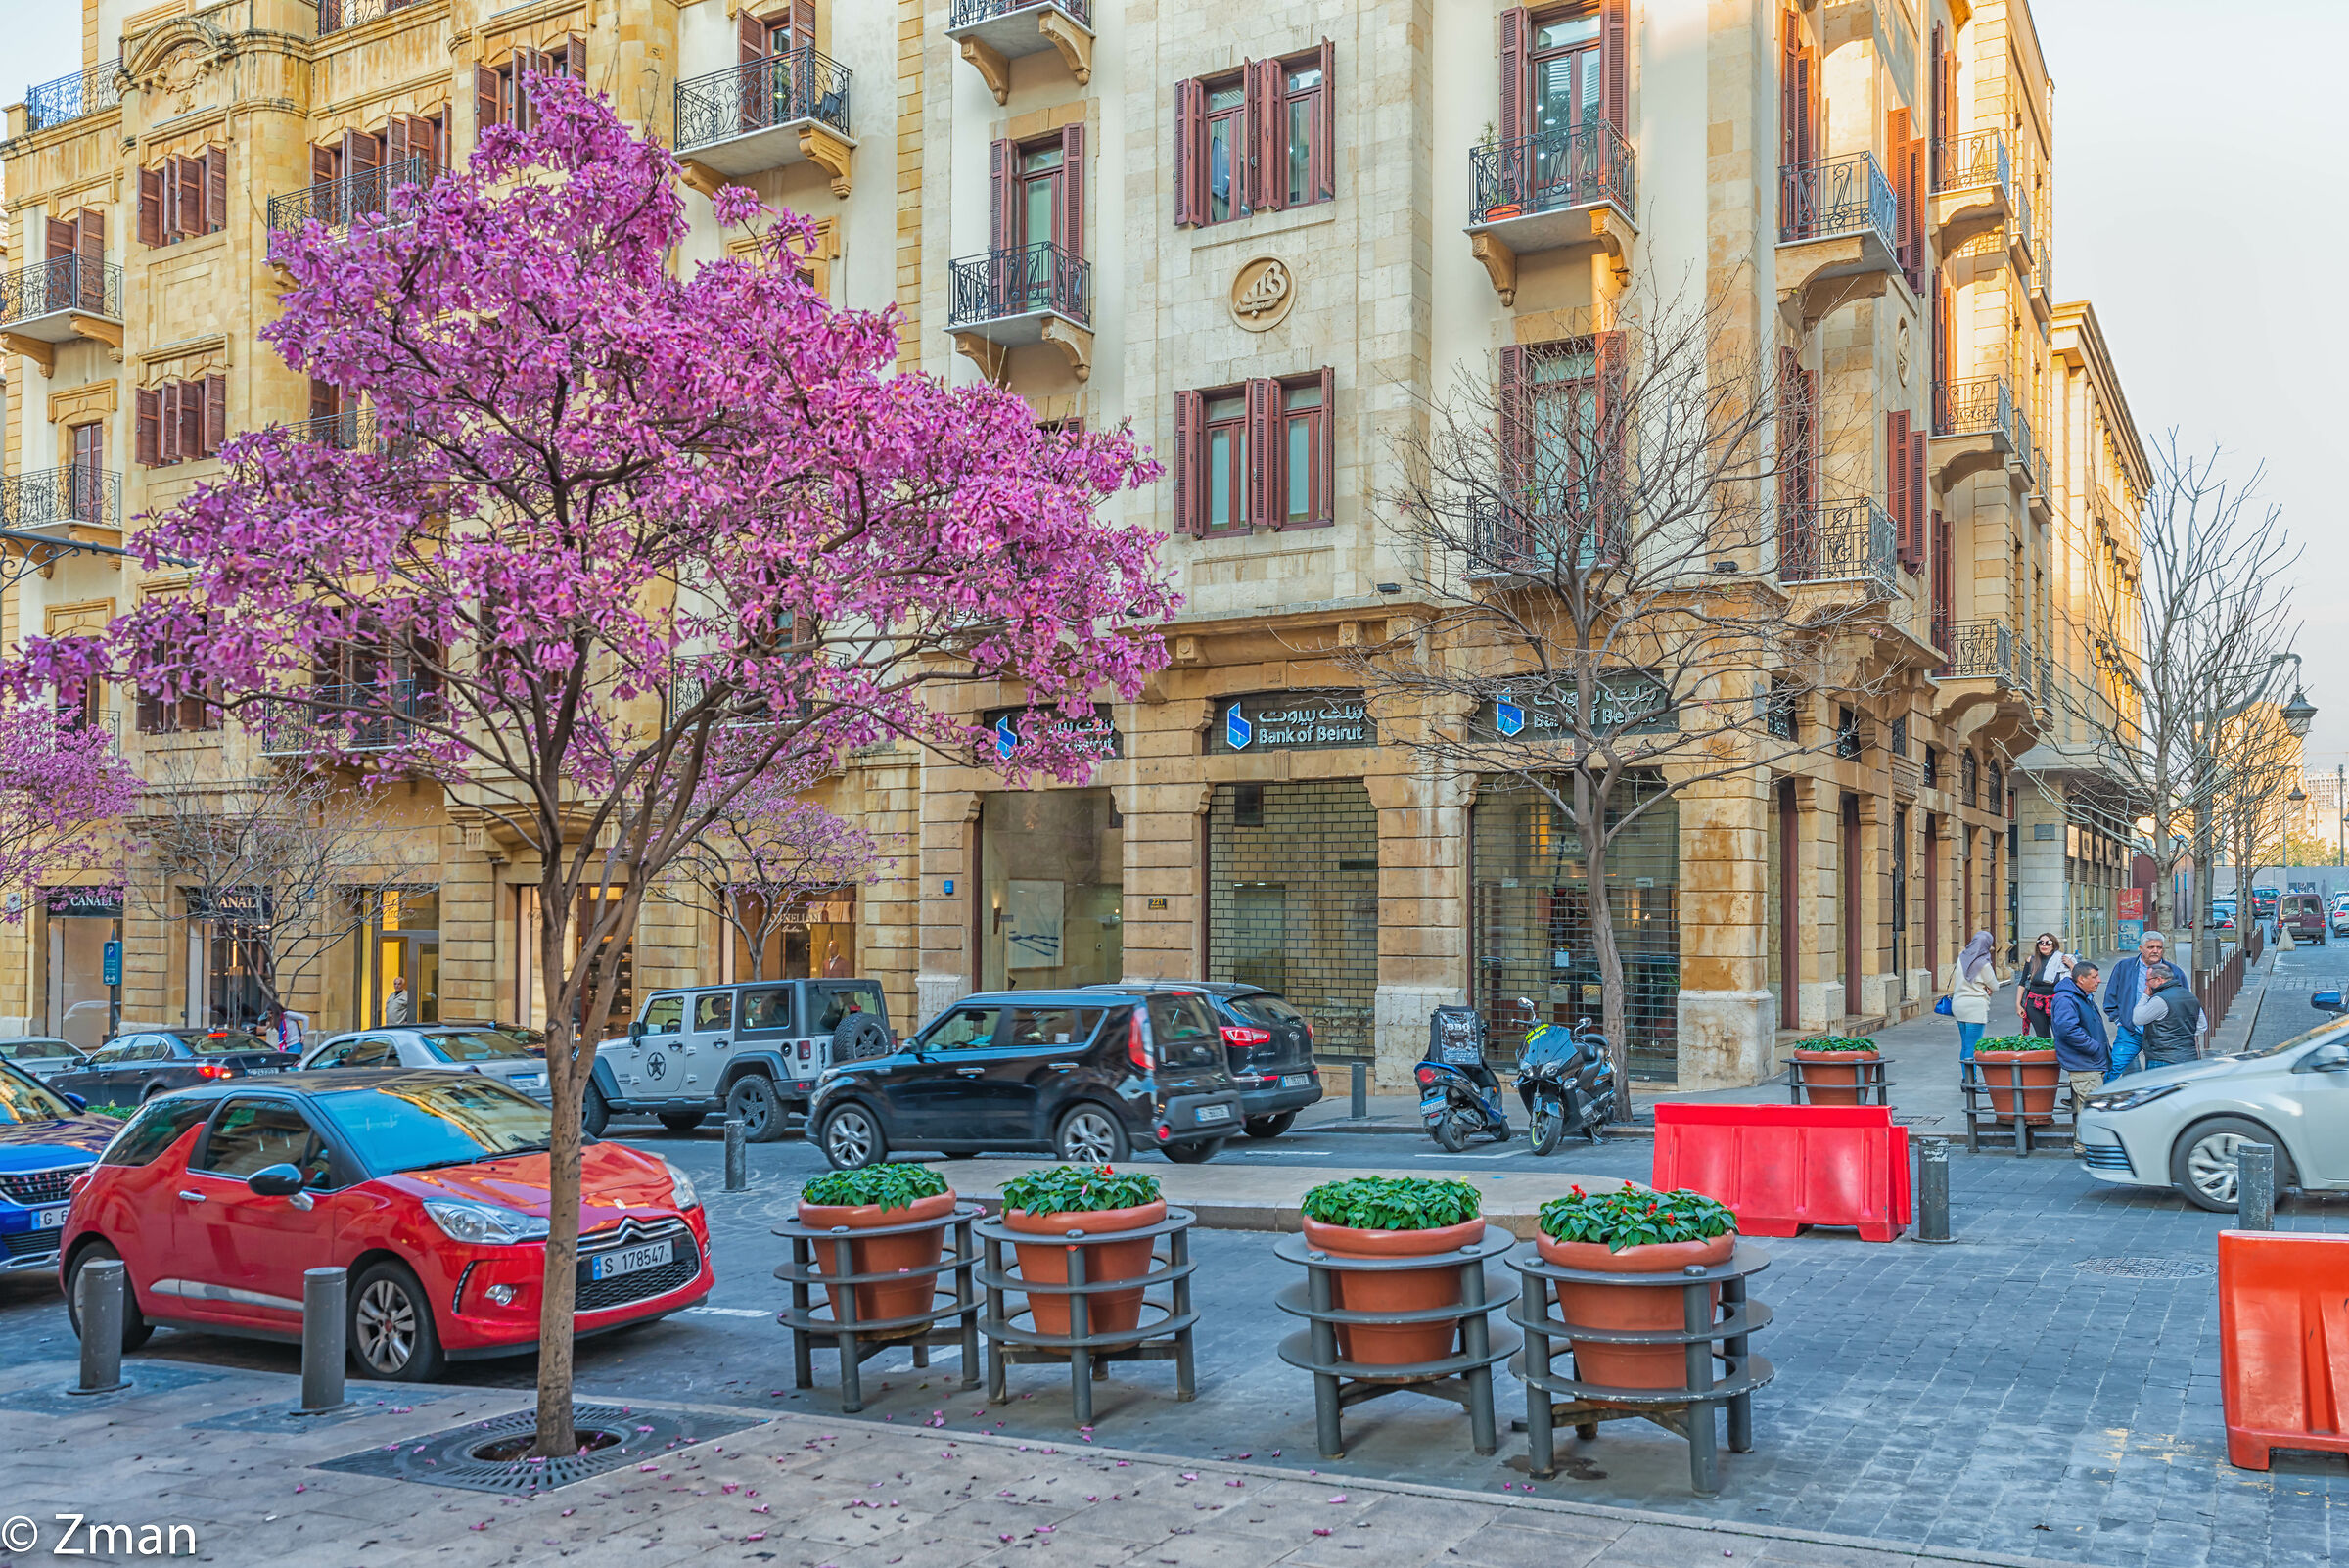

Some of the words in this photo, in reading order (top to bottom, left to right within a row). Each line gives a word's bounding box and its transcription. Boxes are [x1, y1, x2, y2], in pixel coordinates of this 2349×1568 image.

[1258, 709, 1316, 726] بيروت
[1319, 705, 1364, 724] بنك
[1259, 726, 1295, 744] Bank
[1297, 724, 1314, 742] of
[1316, 725, 1363, 742] Beirut
[70, 897, 112, 907] CANALI
[212, 896, 261, 908] ANAL
[763, 913, 822, 923] ONELIANI
[108, 945, 114, 956] P
[44, 1212, 52, 1225] G
[604, 1257, 614, 1274] S
[622, 1245, 665, 1270] 178547
